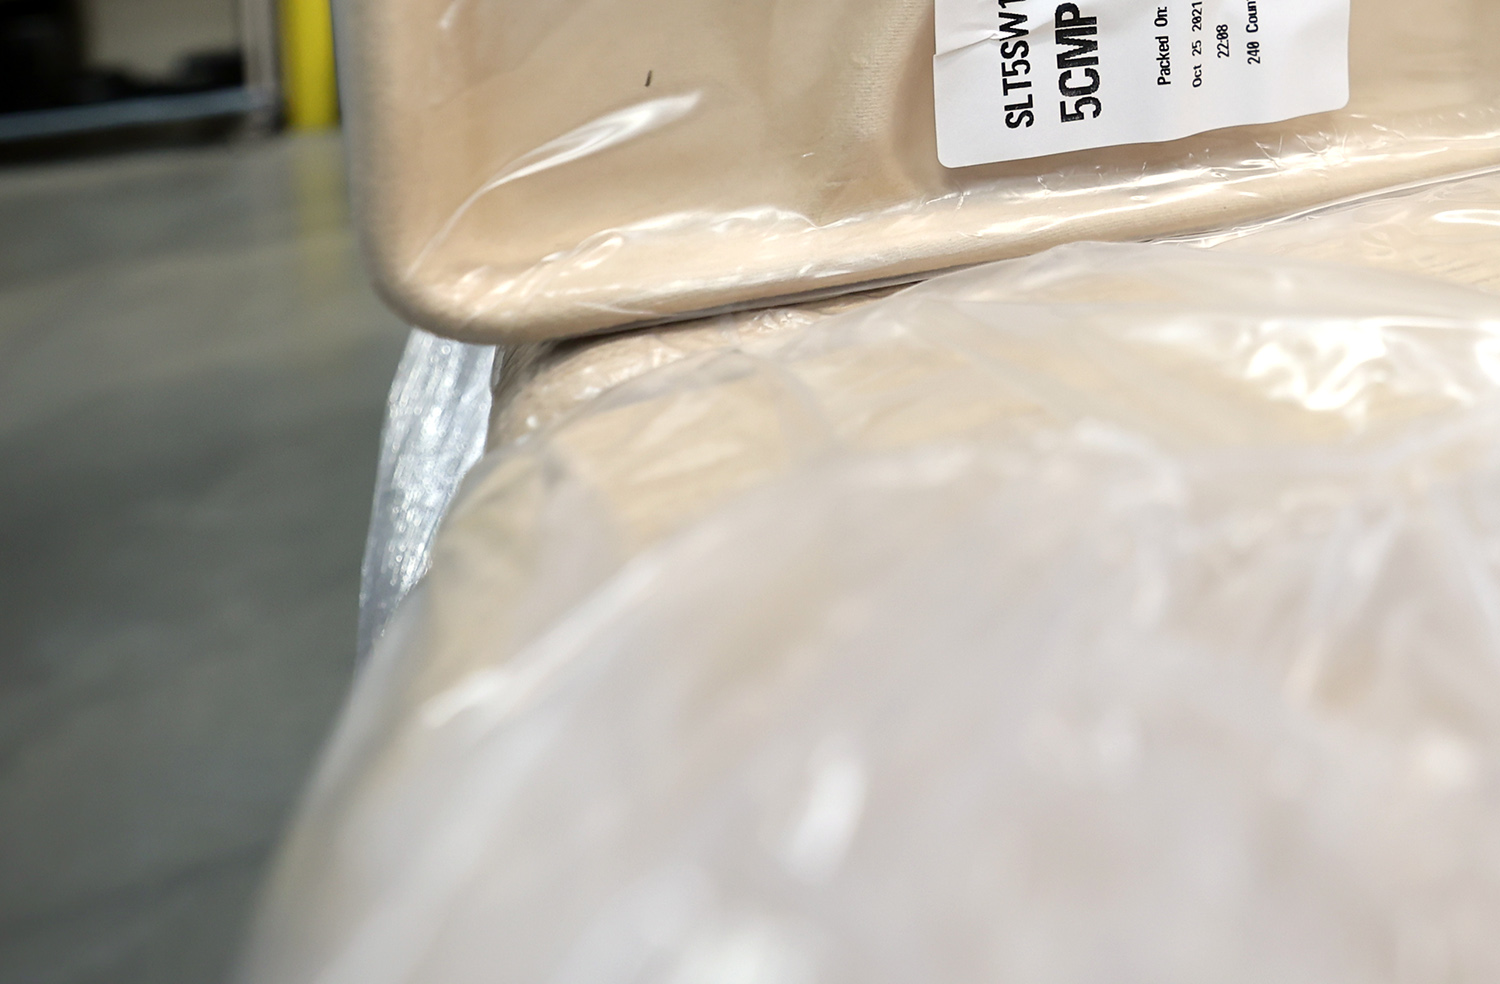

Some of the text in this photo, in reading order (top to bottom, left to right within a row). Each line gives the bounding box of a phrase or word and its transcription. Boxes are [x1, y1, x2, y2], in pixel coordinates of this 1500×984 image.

[1054, 2, 1101, 123] 5CMP
[1154, 6, 1171, 86] Packed On:
[1191, 1, 1203, 88] Oct 25 2021
[1216, 23, 1230, 58] 22:08
[1246, 42, 1261, 65] 240
